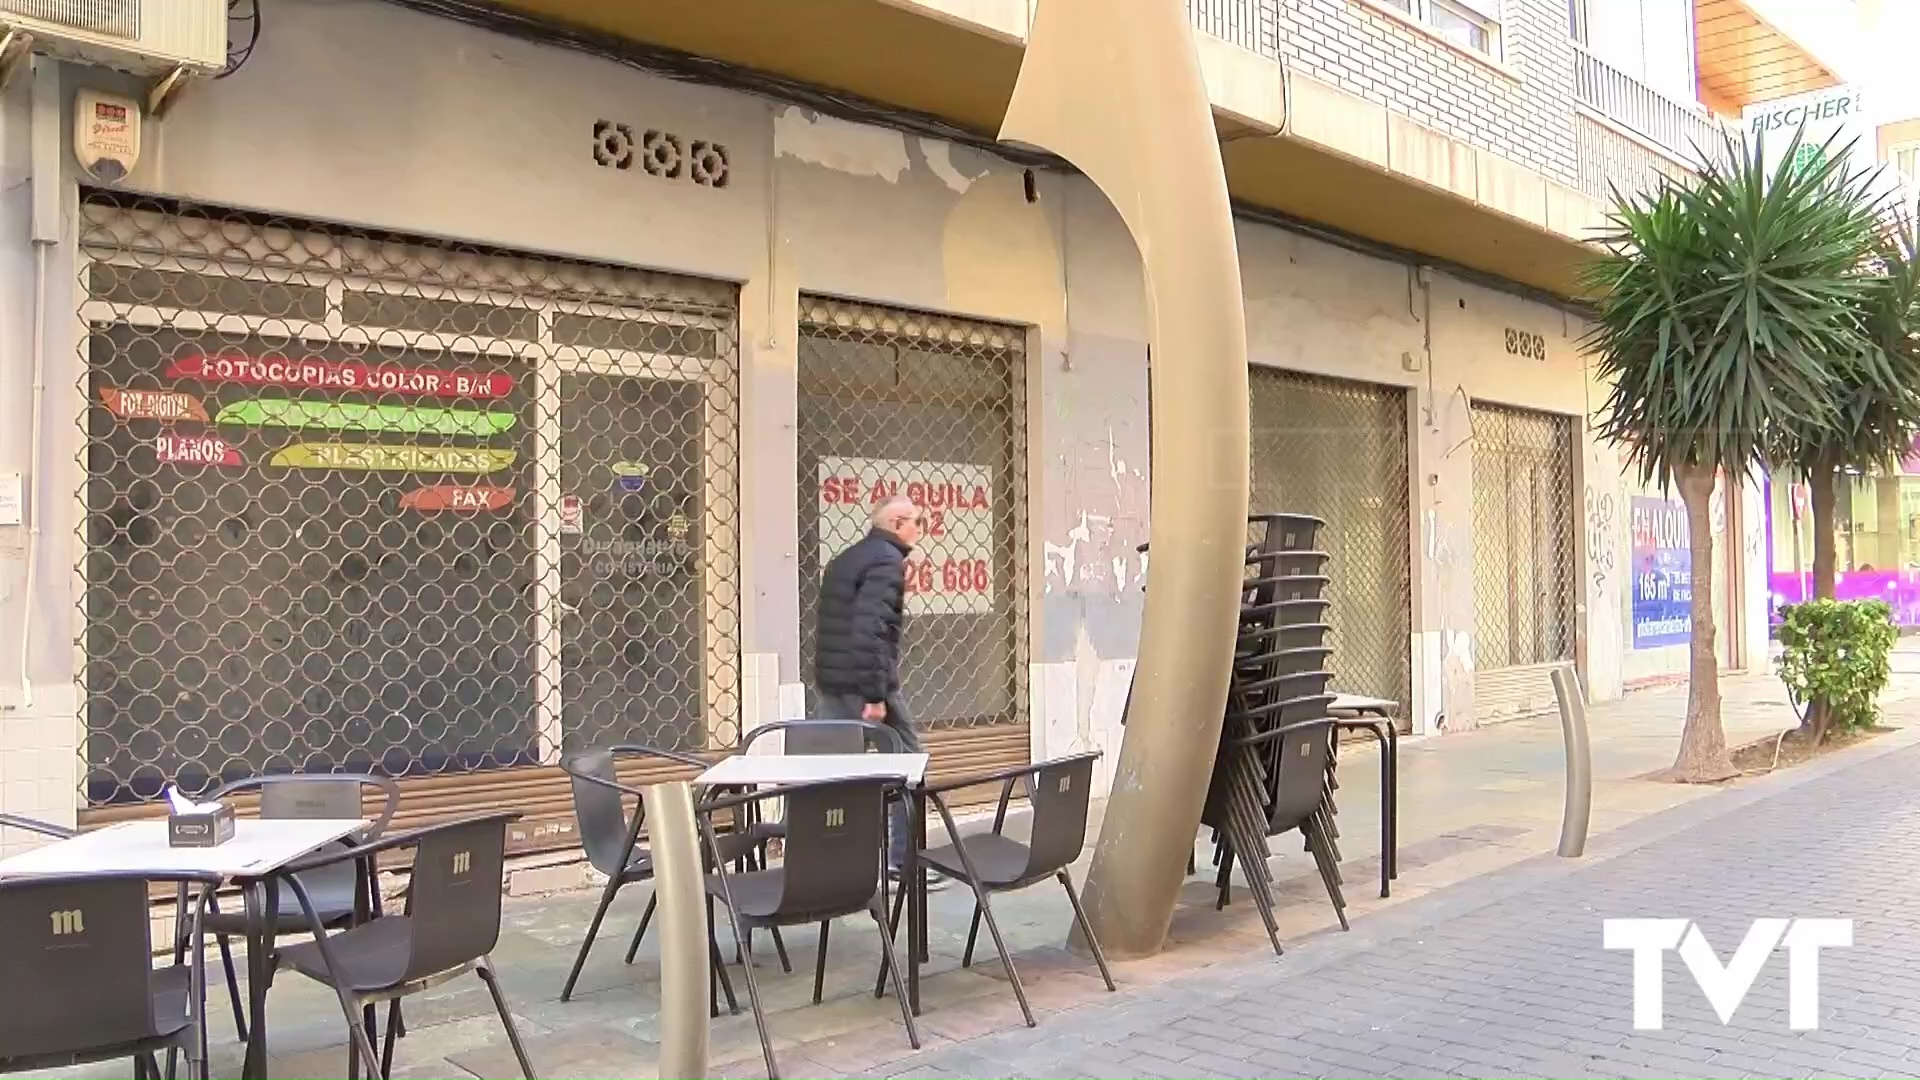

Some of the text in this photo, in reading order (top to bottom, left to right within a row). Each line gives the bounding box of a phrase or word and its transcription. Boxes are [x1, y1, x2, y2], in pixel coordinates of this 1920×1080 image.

[1752, 97, 1850, 134] FISCHER
[202, 359, 356, 386] FOTOCOPIAS
[367, 371, 439, 392] COLOR
[156, 437, 225, 462] PLANOS
[317, 447, 490, 469] PLASTIFICADOS
[453, 491, 490, 508] FAX
[823, 477, 859, 504] SE
[1652, 508, 1691, 549] ALQUIL
[904, 559, 934, 592] 26
[1639, 572, 1656, 600] 165
[826, 808, 844, 827] m
[453, 851, 470, 874] m
[50, 909, 85, 935] m
